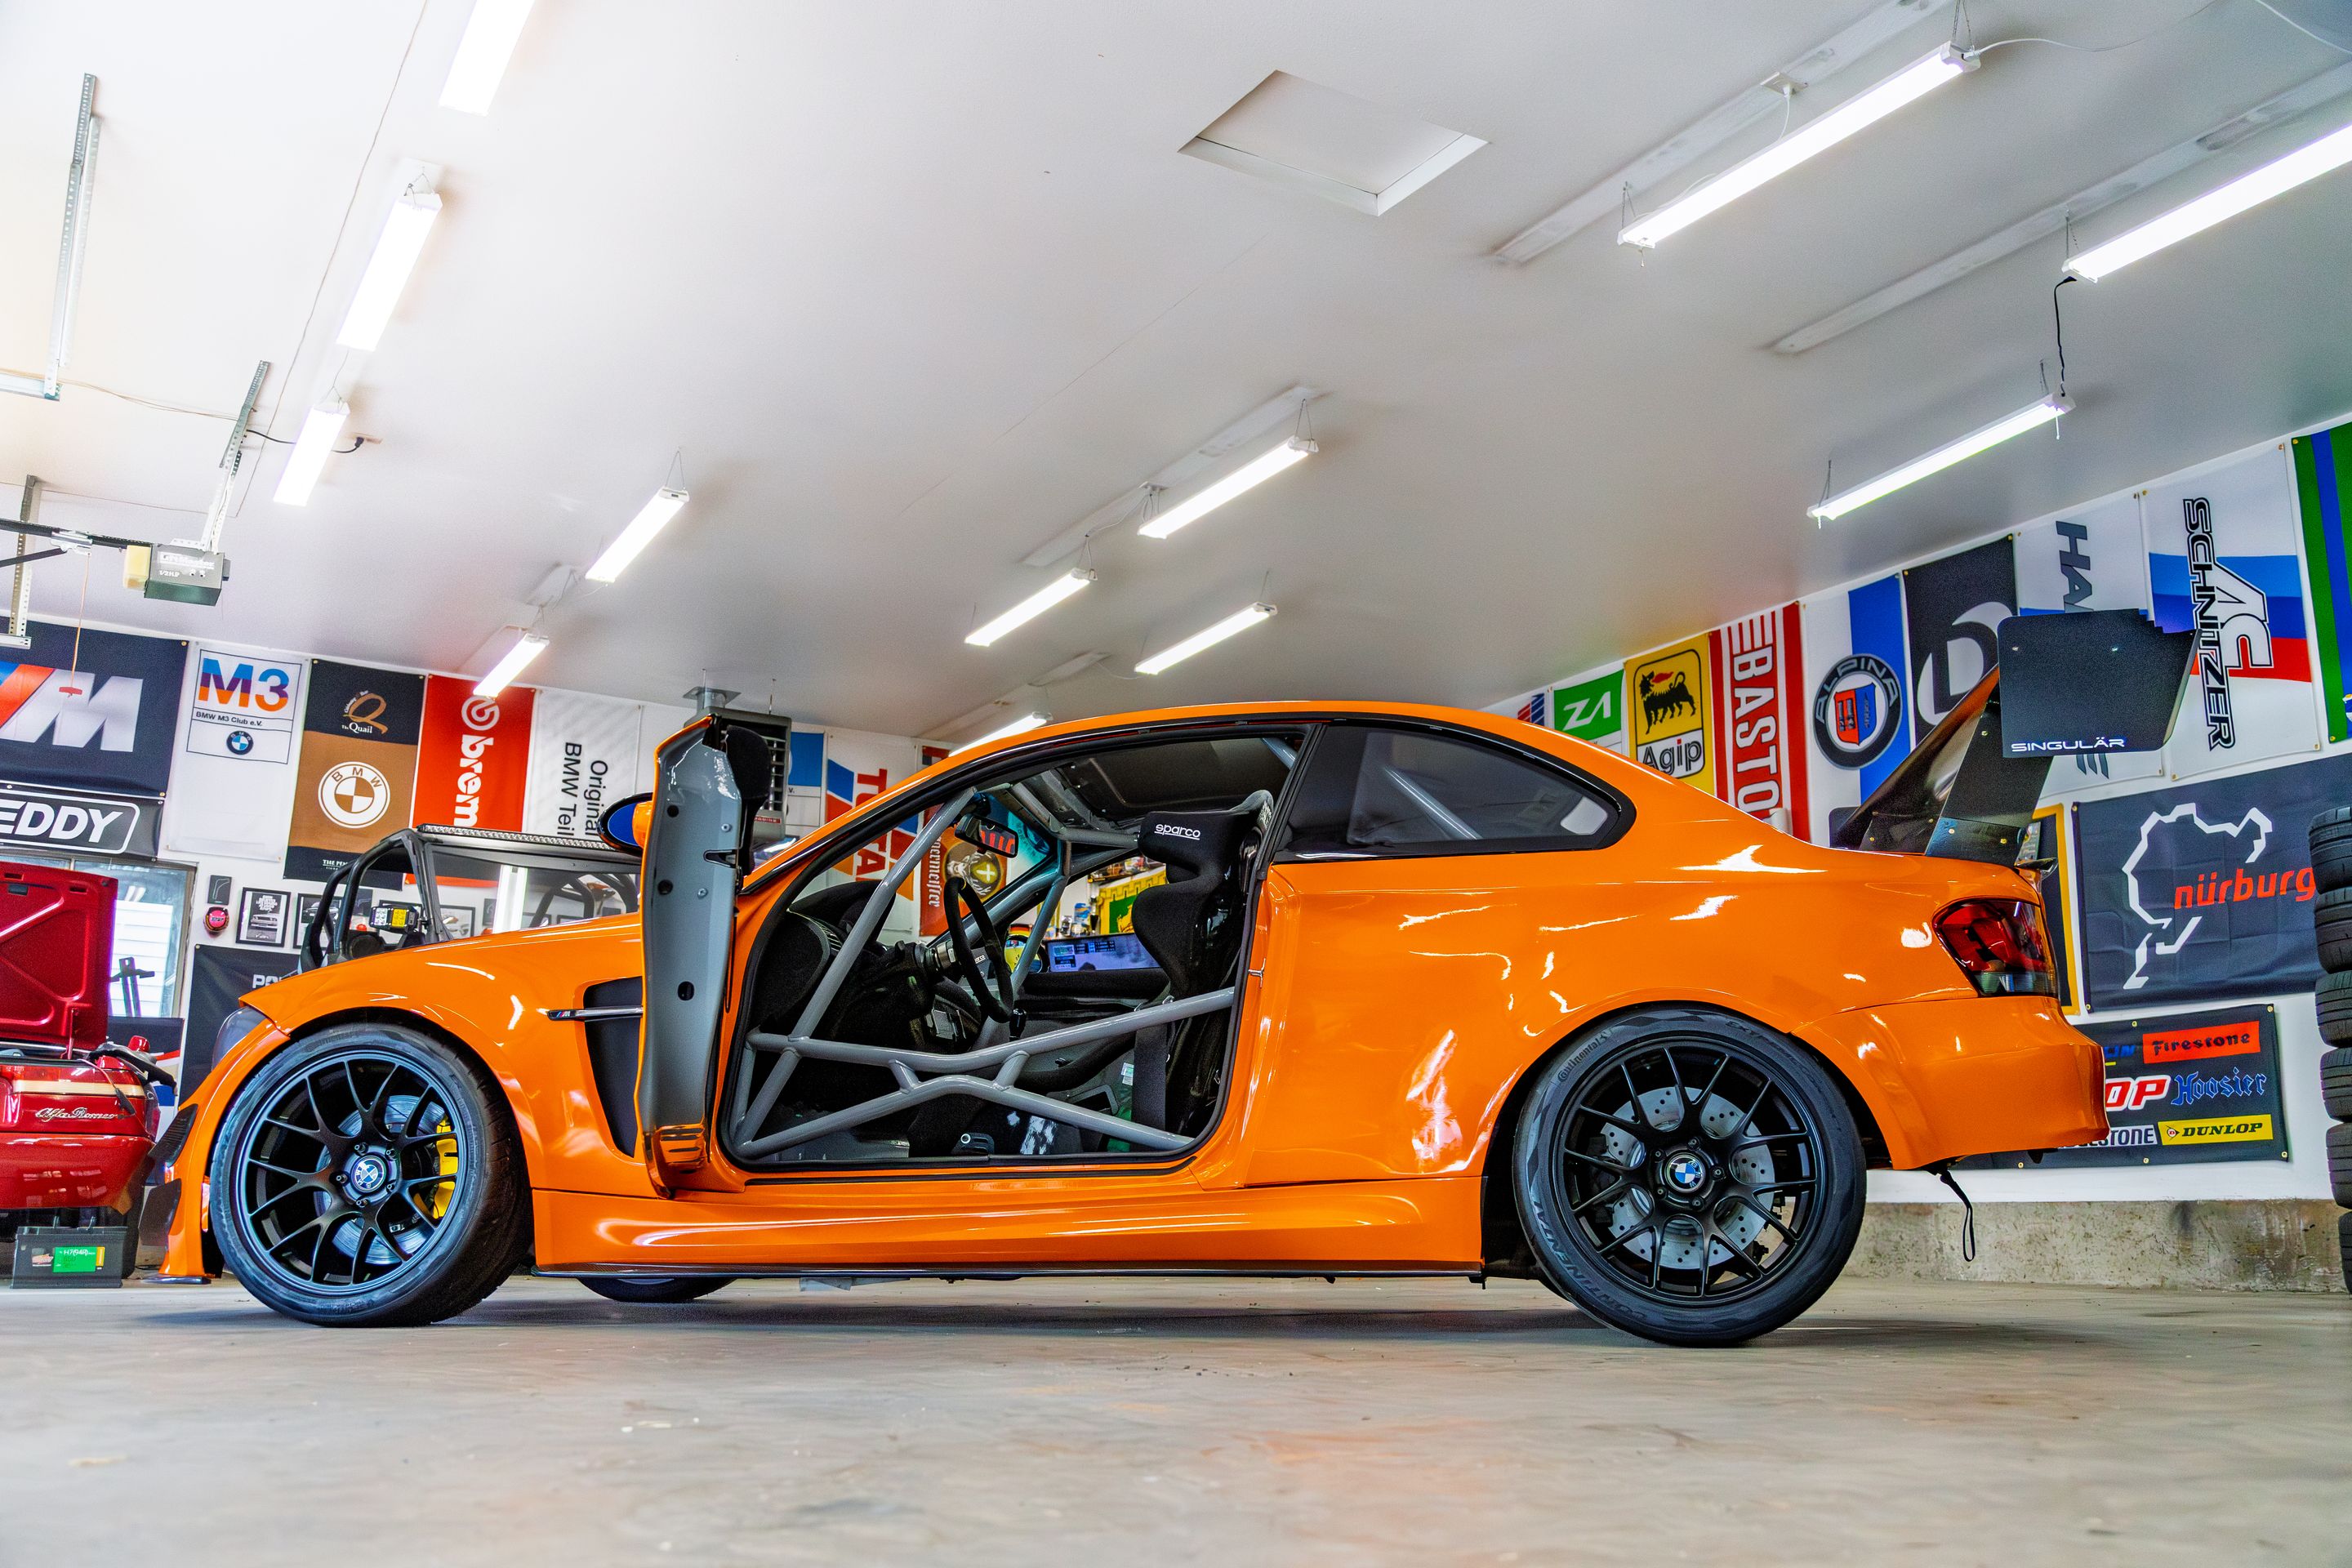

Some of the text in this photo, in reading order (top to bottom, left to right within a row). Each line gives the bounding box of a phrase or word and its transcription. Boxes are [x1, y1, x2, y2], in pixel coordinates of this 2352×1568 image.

[198, 657, 290, 712] M3
[1815, 657, 1899, 725] ALPINA
[196, 710, 216, 719] BMW
[231, 717, 248, 725] Club
[349, 722, 373, 733] Quail
[1642, 738, 1702, 775] Agip
[2011, 737, 2126, 754] SINGULÄR
[332, 766, 382, 788] BMW
[452, 735, 493, 827] brem
[556, 742, 582, 836] BMW Teil
[583, 760, 608, 835] Original
[1154, 823, 1201, 840] sparco
[2151, 1031, 2251, 1056] Firestone
[2171, 1067, 2267, 1106] Hoosier
[72, 1107, 118, 1120] Romeo
[2181, 1121, 2263, 1137] DUNLOP
